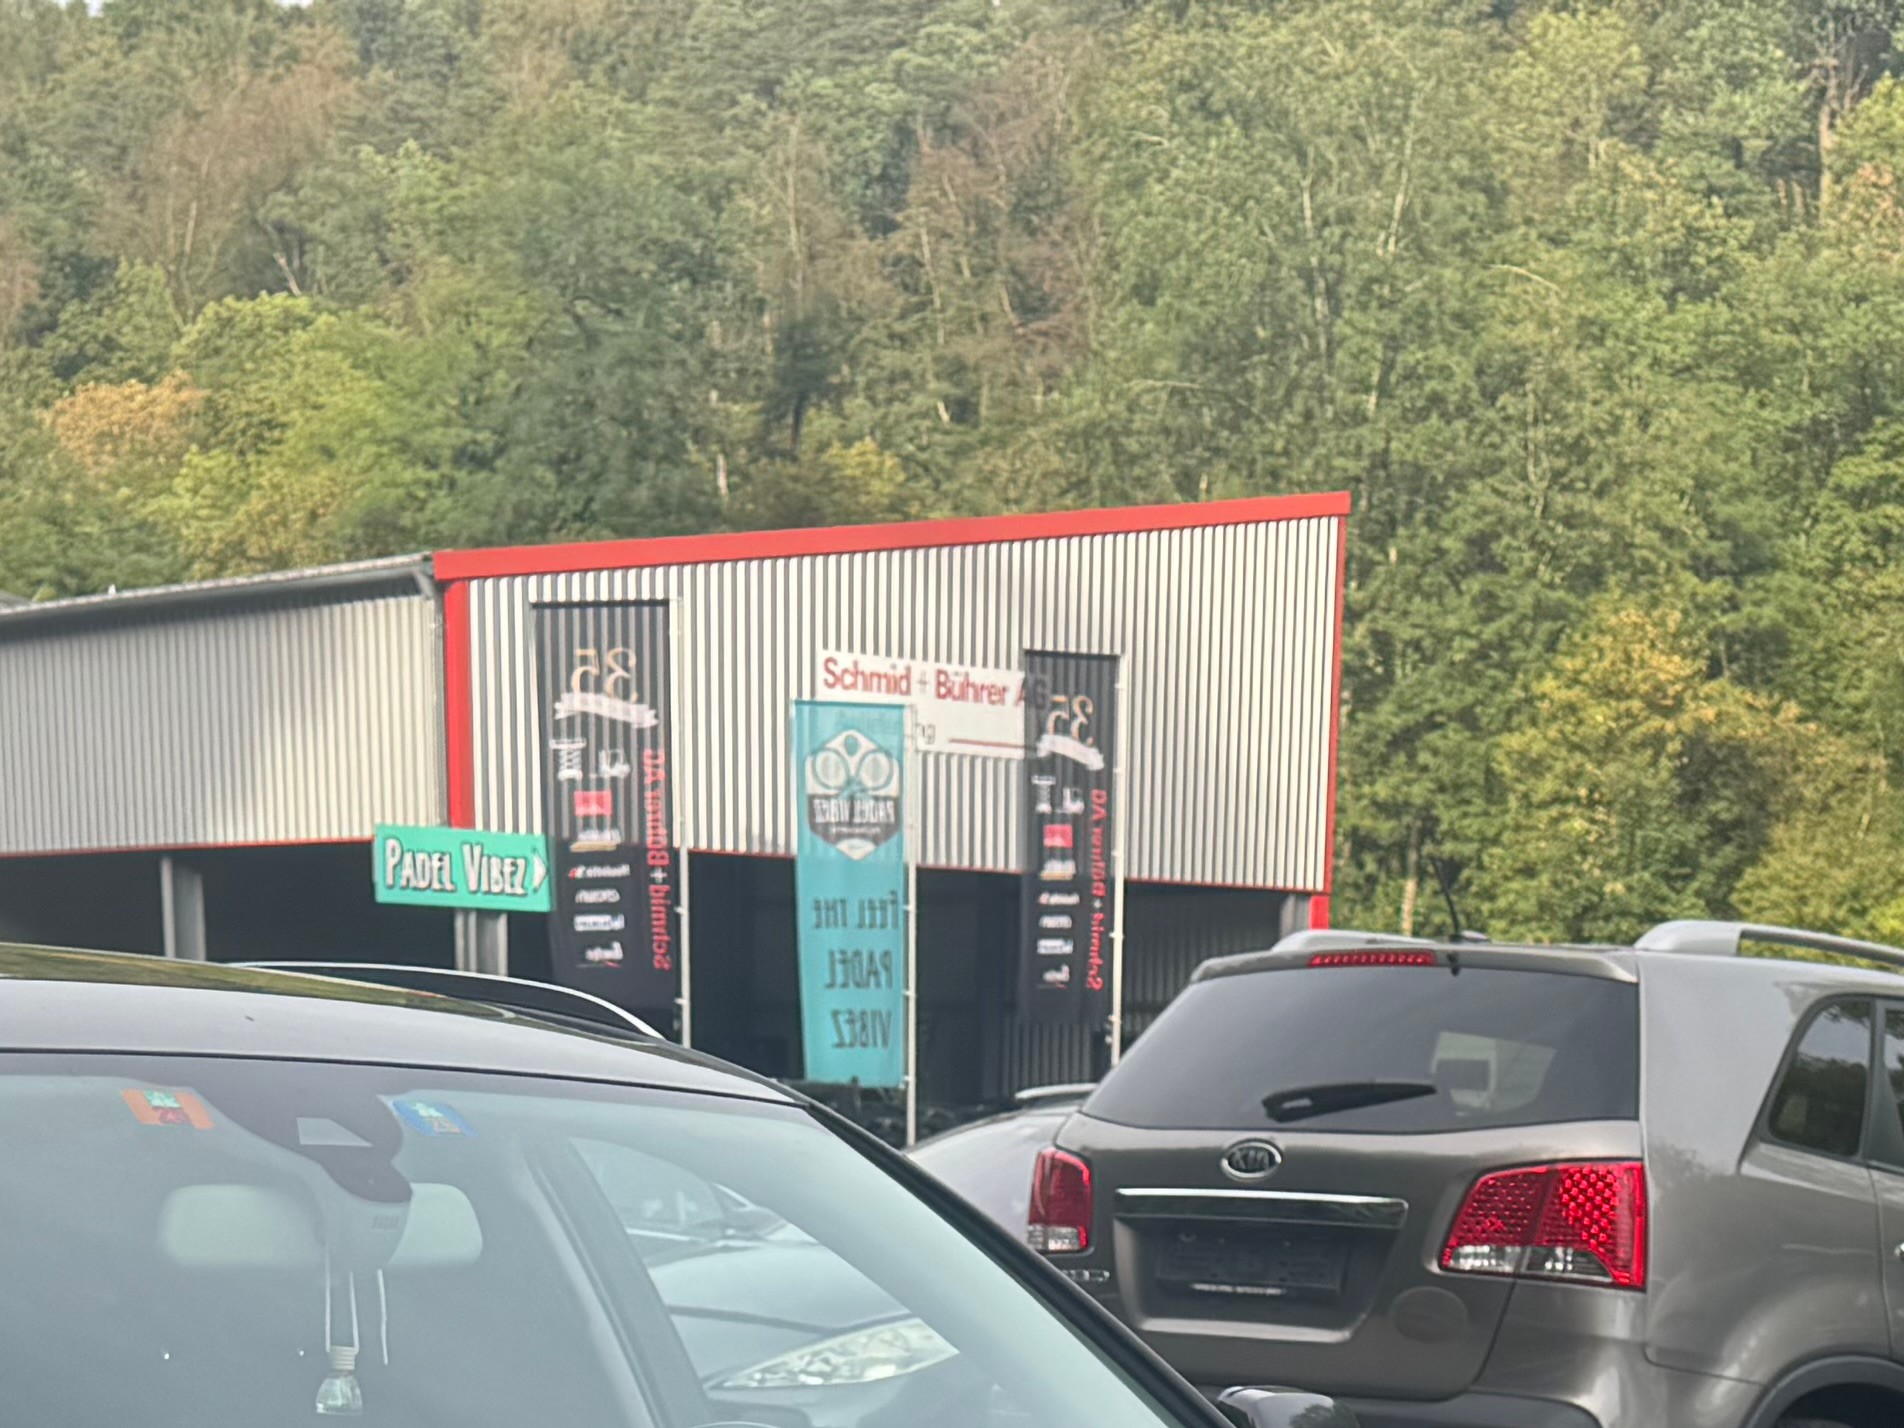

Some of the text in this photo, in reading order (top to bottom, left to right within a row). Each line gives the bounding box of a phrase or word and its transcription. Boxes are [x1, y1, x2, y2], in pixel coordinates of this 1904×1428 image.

[822, 656, 911, 697] Schmid
[935, 668, 1007, 706] Bührer
[384, 836, 528, 896] PADEL VIBEZ
